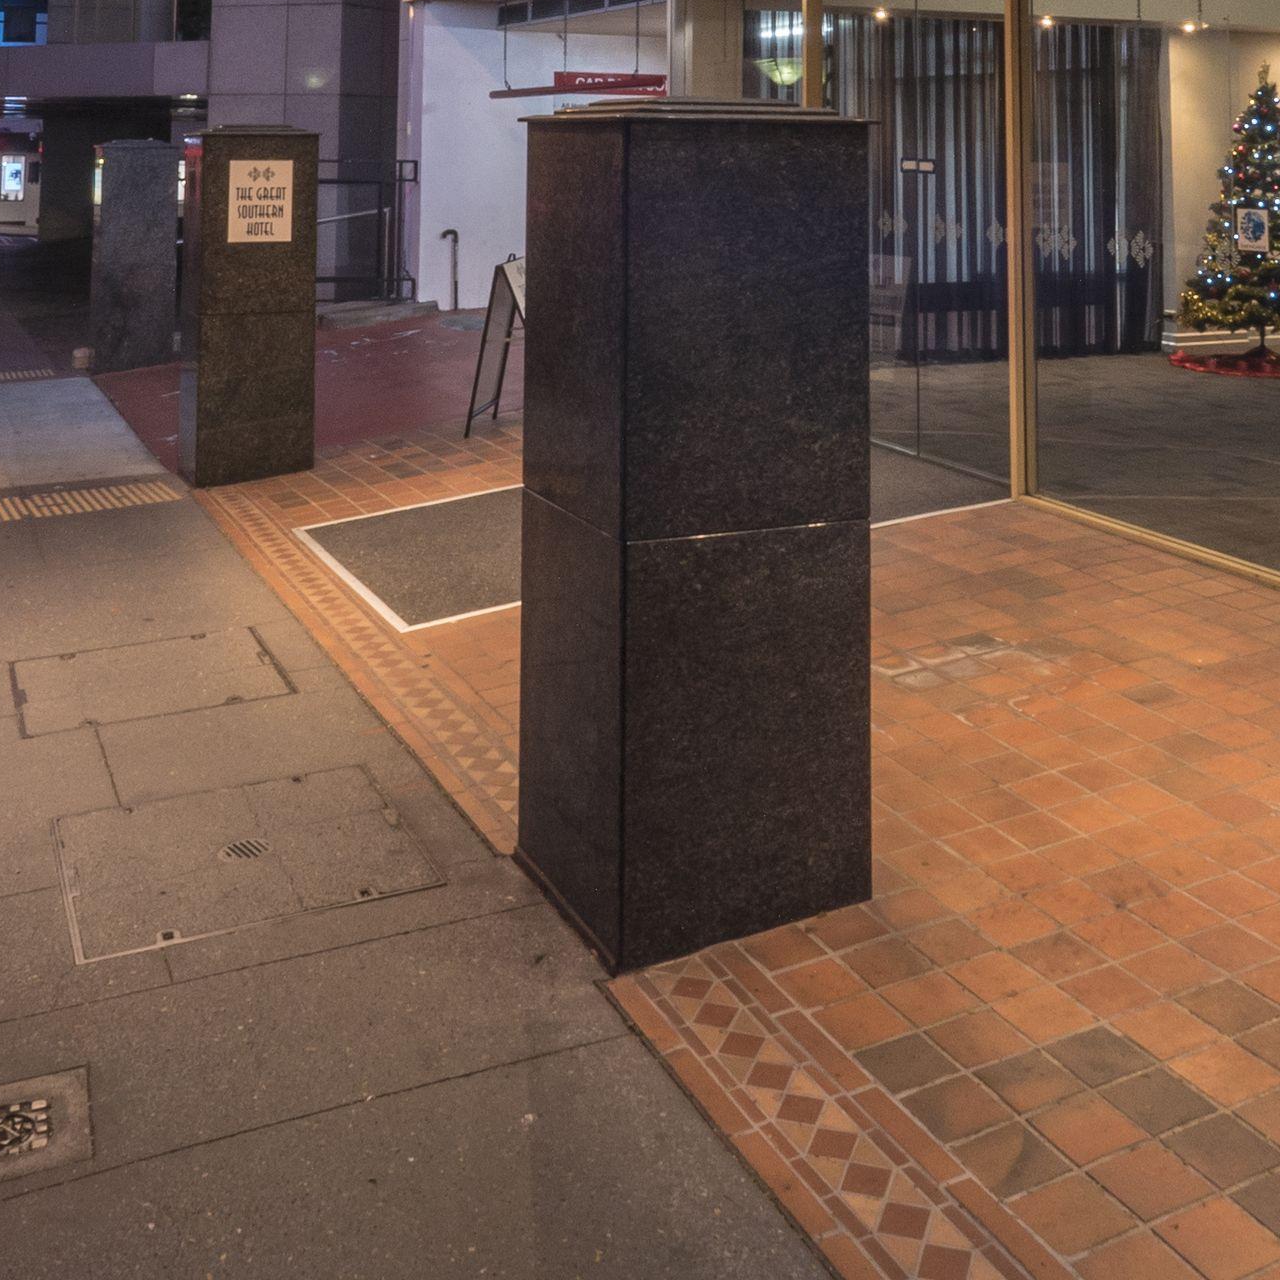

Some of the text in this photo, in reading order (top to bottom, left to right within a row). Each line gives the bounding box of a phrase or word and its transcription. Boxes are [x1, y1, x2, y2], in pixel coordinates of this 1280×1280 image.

[236, 186, 287, 201] THE GREAT
[237, 204, 284, 219] SOUTHERN
[246, 222, 275, 236] HOTEL
